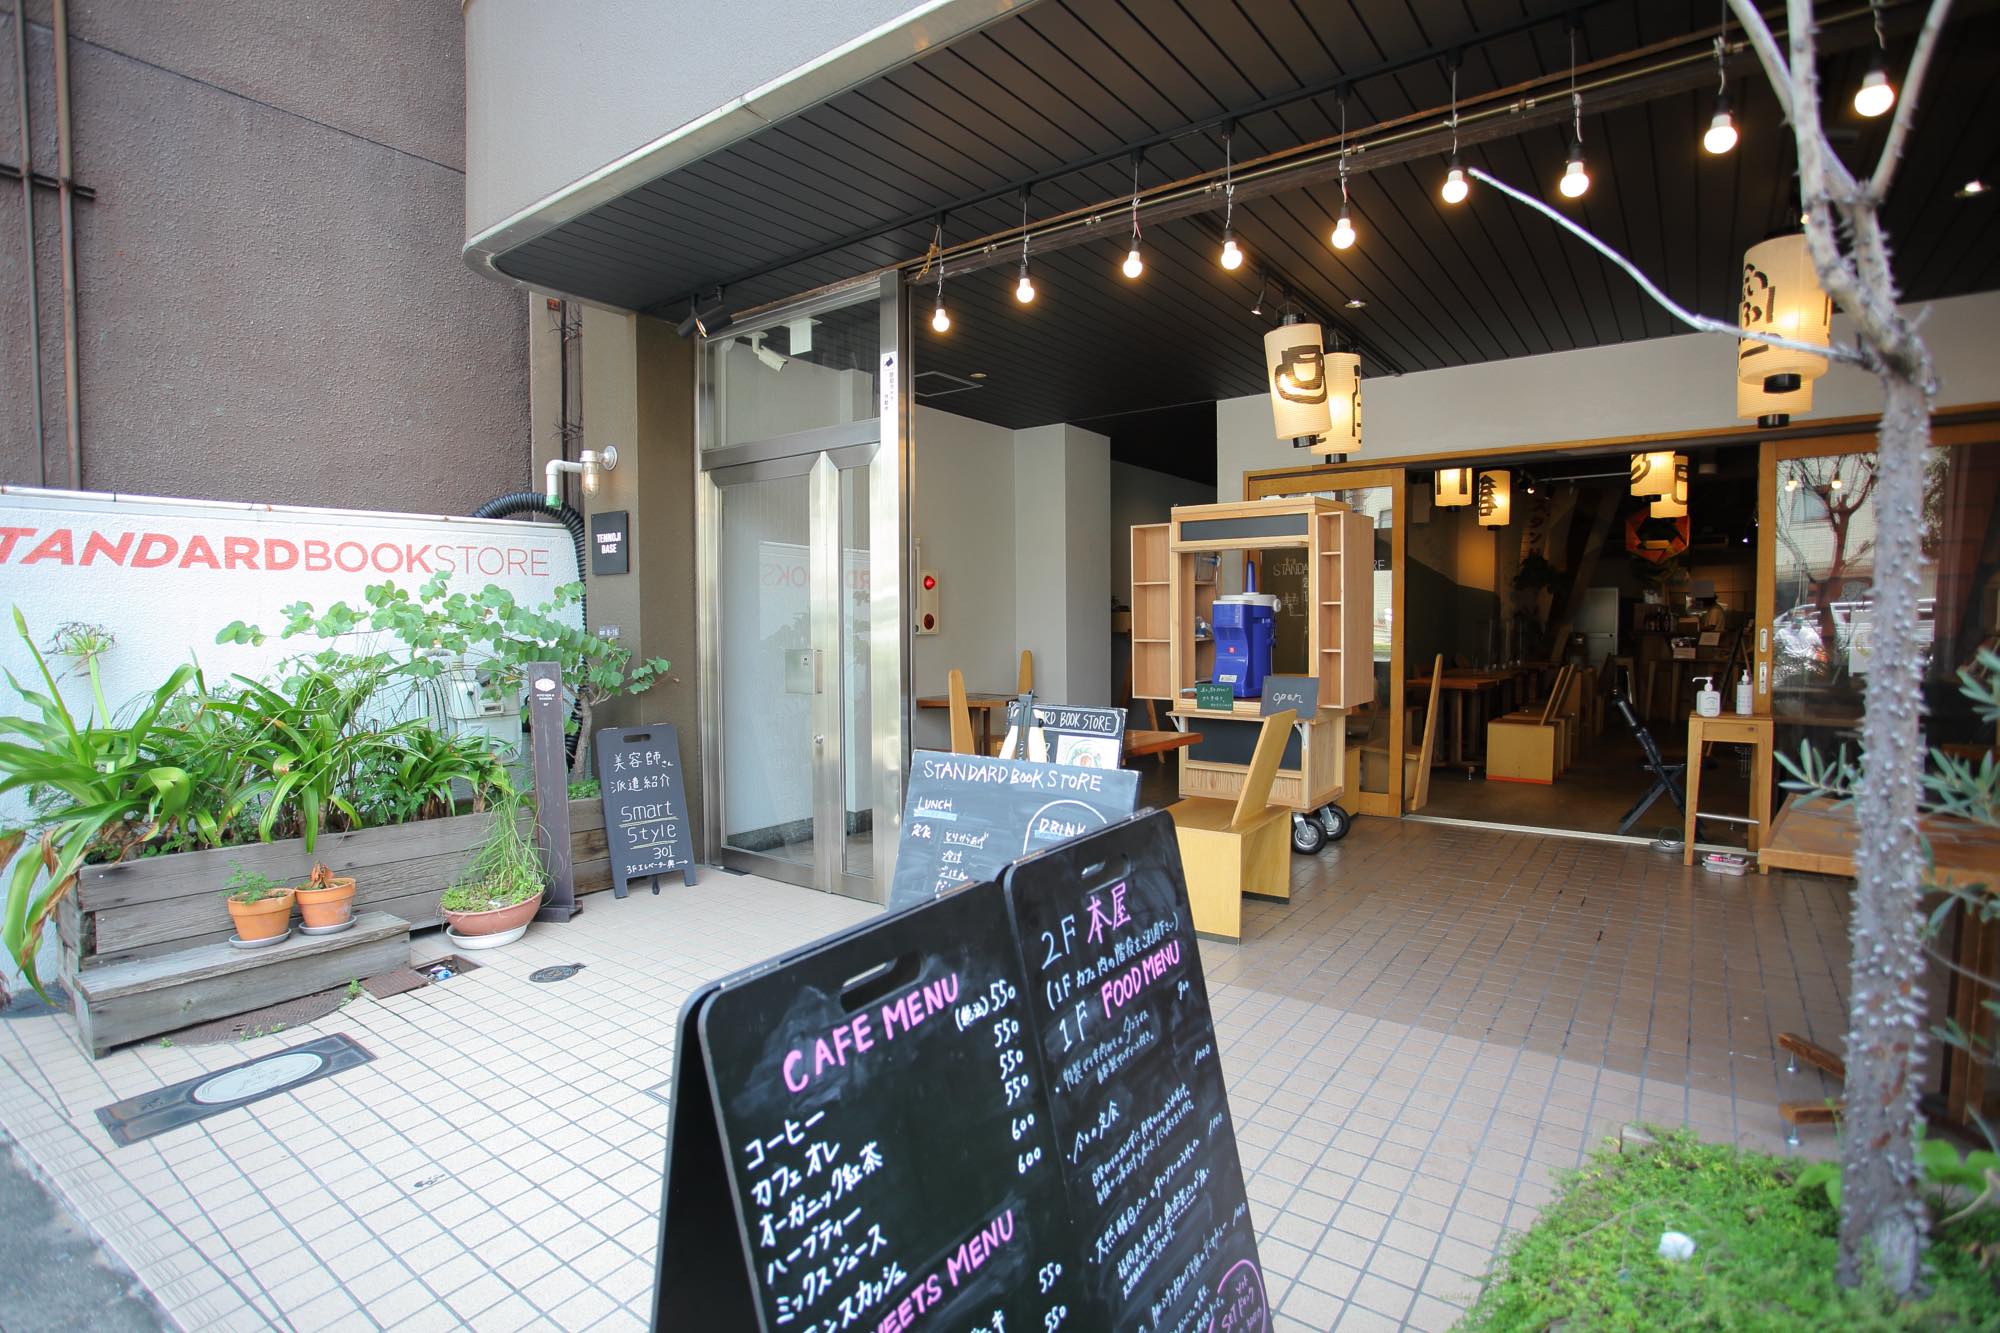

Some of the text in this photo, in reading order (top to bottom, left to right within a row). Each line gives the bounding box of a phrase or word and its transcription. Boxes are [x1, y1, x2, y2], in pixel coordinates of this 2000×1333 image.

[596, 531, 622, 543] TENNOJI
[601, 544, 617, 554] BASE
[1060, 711, 1081, 728] BOOK
[1082, 713, 1113, 731] STORE
[612, 751, 674, 773] 美容師さん
[923, 760, 1009, 785] STANDARD
[1047, 769, 1103, 793] STORE
[610, 773, 671, 794] 派遣紹介
[917, 797, 953, 812] LUNCH
[911, 823, 932, 839] 定食
[653, 847, 675, 860] 301
[1040, 882, 1131, 970] 2F 本屋
[1058, 940, 1181, 1052] 1F FOOD MENU
[781, 973, 960, 1094] CAFE MENU
[993, 1018, 1019, 1048] 550
[744, 1110, 826, 1171] コーヒー
[989, 979, 1017, 1012] 550
[1011, 1113, 1036, 1141] 600
[759, 1048, 1024, 1248] オーガニック紅茶 550
[1017, 1146, 1043, 1175] 600
[767, 1074, 1030, 1286] ハーブティー 550
[946, 1209, 1015, 1287] MENU
[1038, 1262, 1063, 1294] 550
